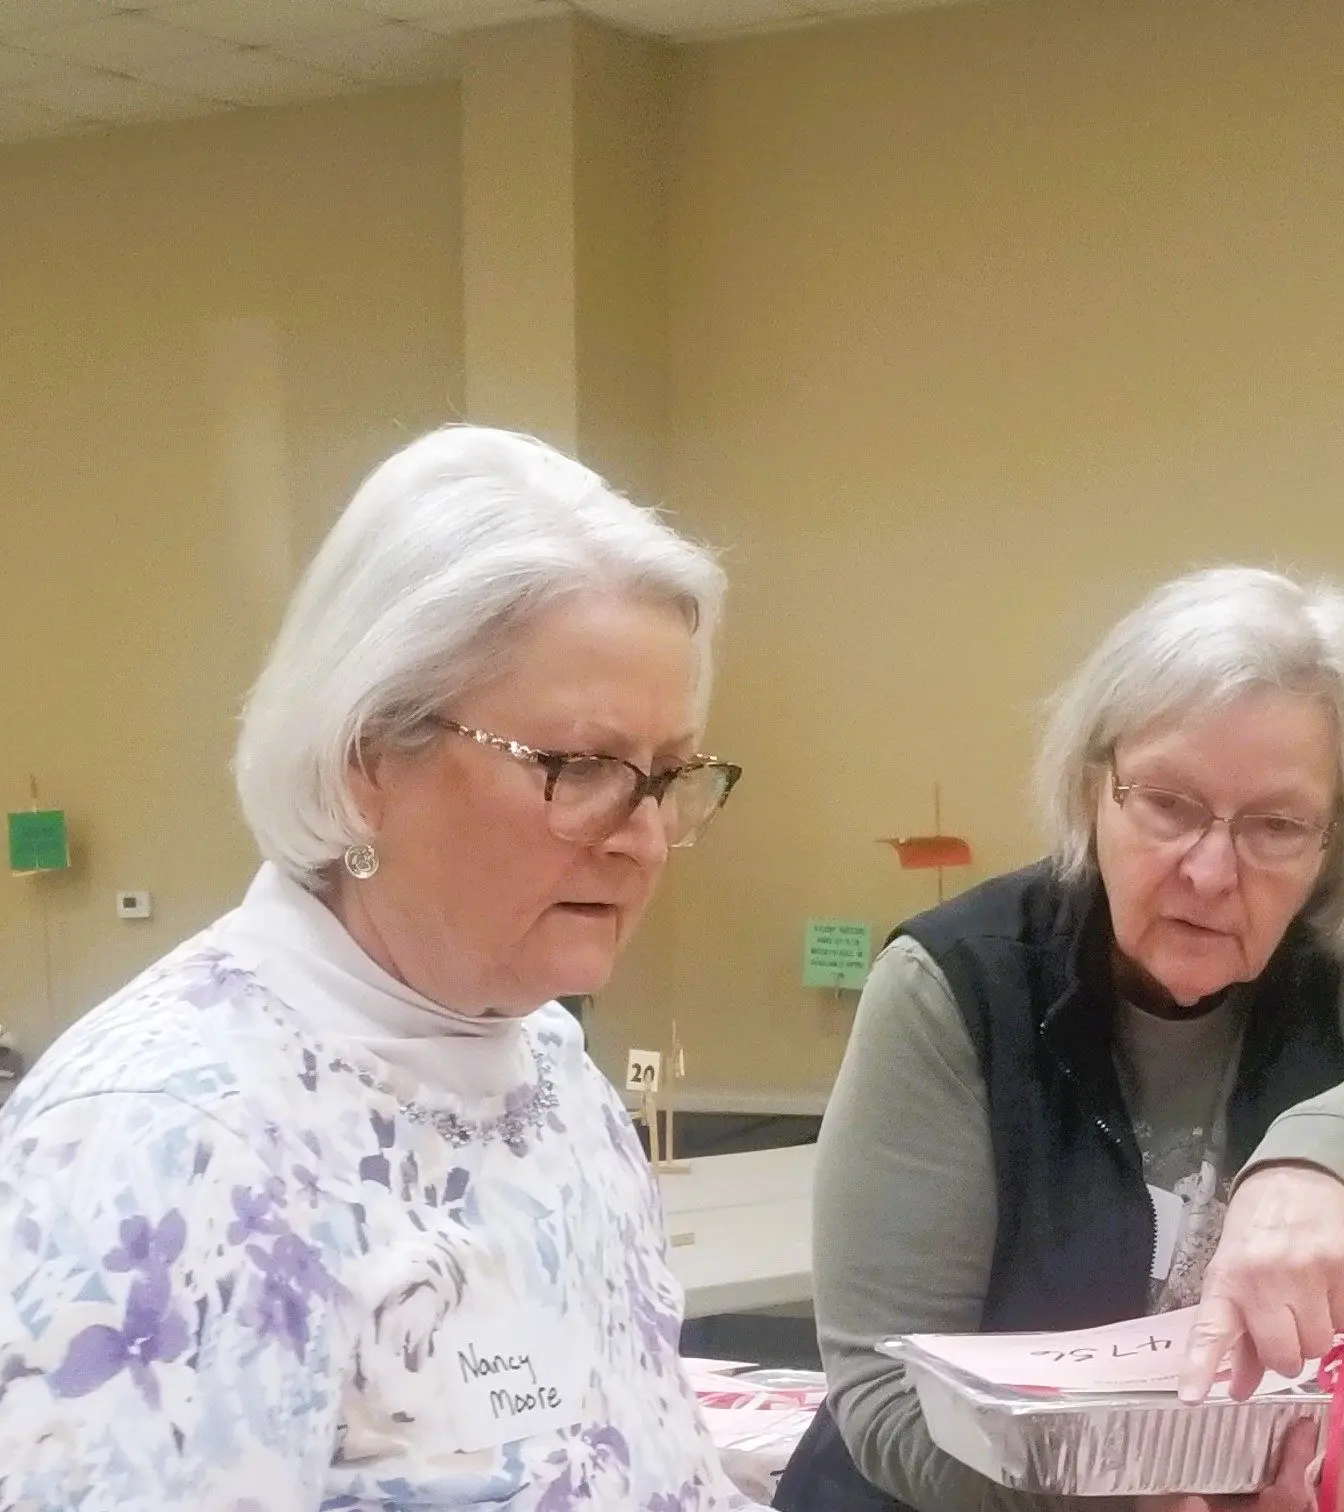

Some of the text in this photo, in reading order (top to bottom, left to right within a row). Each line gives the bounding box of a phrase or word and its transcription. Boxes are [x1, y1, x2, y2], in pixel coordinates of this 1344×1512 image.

[629, 1062, 655, 1083] 20
[456, 1342, 538, 1385] Nancy
[1030, 1334, 1174, 1364] 4756
[489, 1386, 562, 1419] Moore
